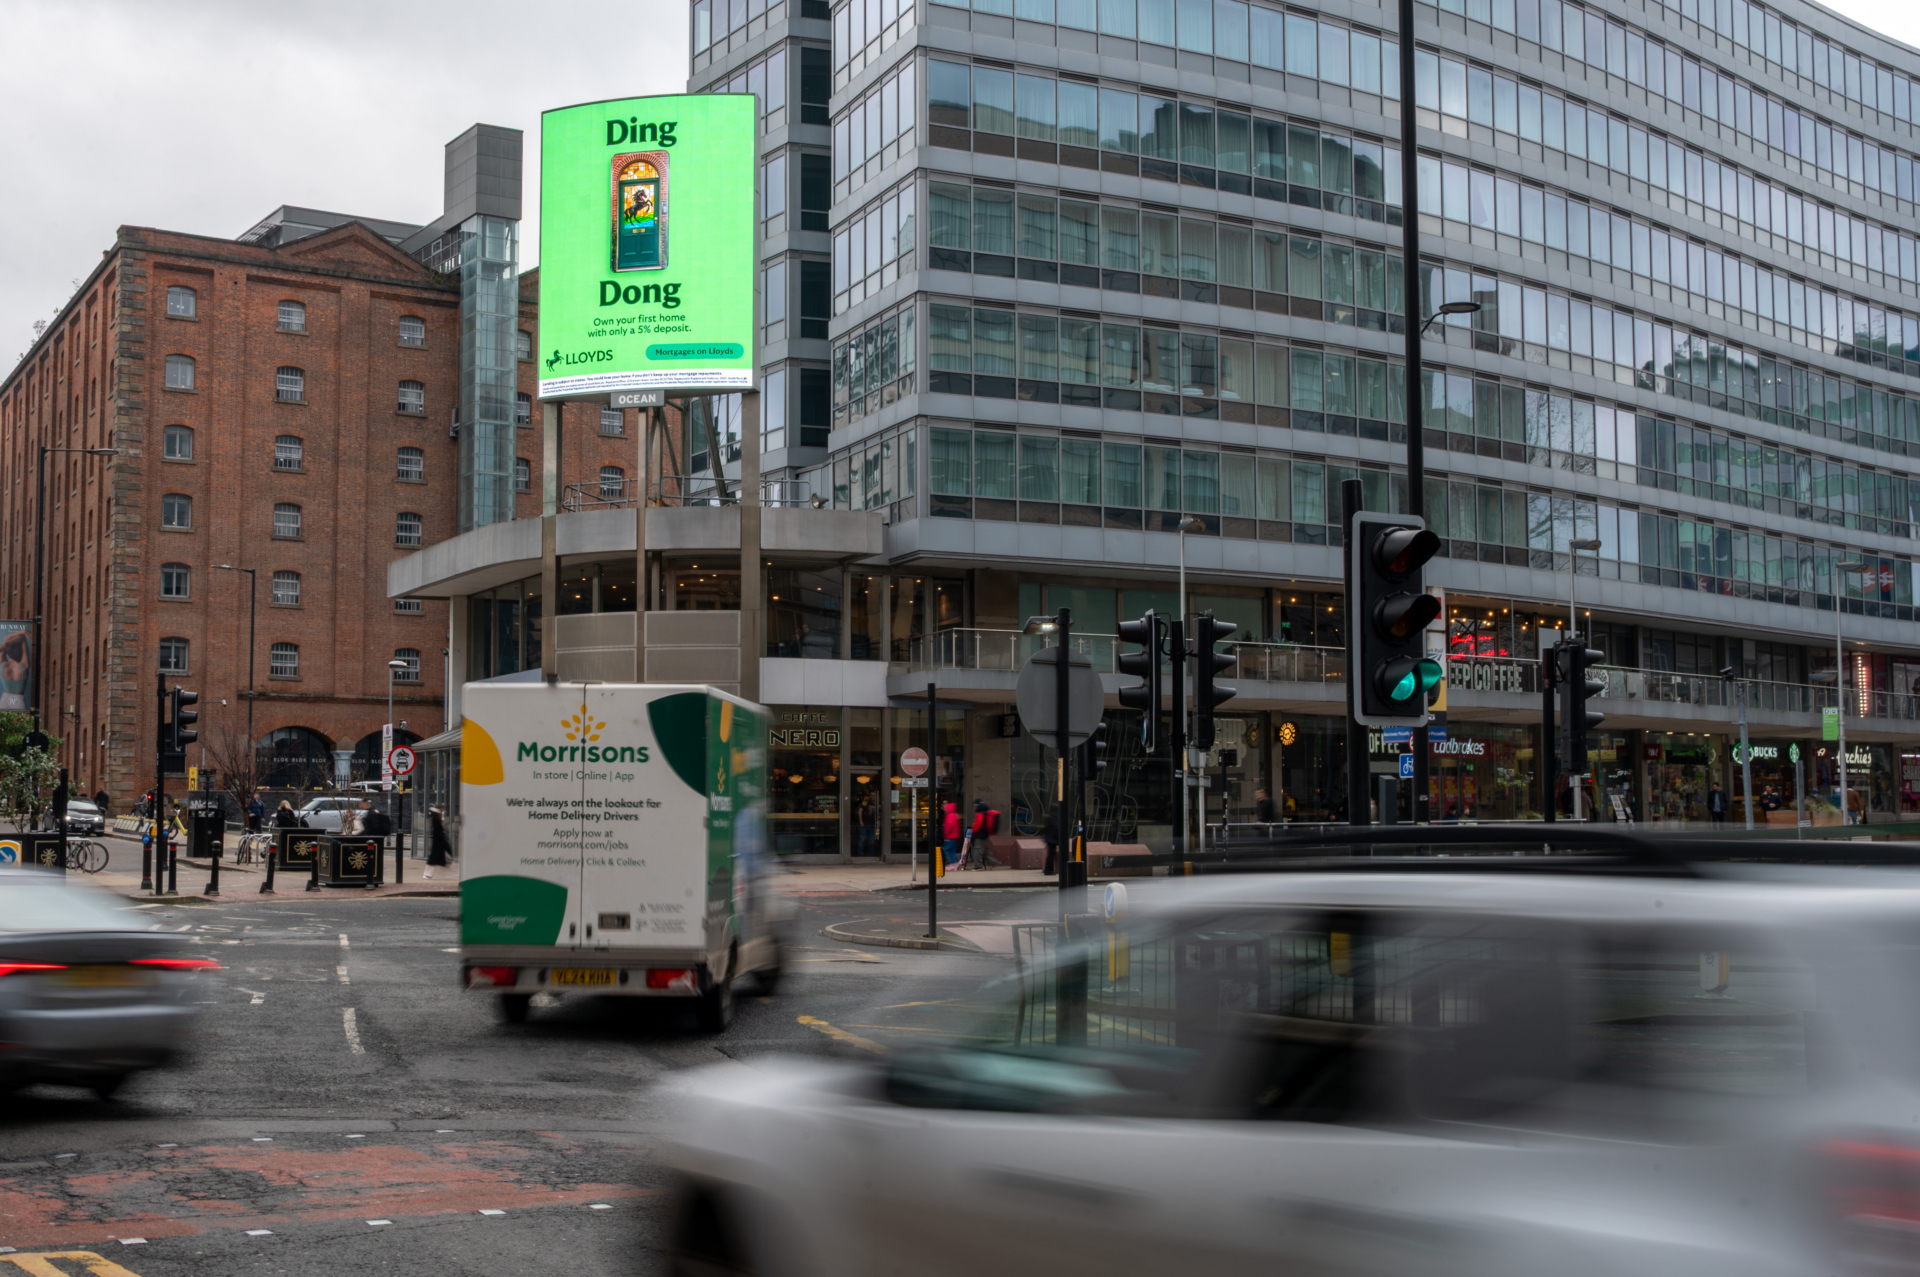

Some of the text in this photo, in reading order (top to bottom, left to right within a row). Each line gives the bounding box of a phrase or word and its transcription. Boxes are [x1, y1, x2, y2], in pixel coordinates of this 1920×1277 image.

[606, 116, 678, 148] Ding
[599, 280, 682, 309] Dong
[593, 313, 686, 327] Own your first home
[587, 328, 606, 338] with
[608, 326, 628, 337] only
[637, 324, 652, 334] 5%
[654, 323, 692, 335] deposit.
[565, 350, 614, 365] LLOYDS
[655, 348, 695, 356] Mortgages
[708, 347, 734, 356] Lloyds
[618, 394, 657, 404] OCEAN
[1450, 662, 1523, 692] EEP COFFEE
[782, 710, 828, 723] CAFFÈ
[770, 729, 840, 746] NERO
[1369, 733, 1400, 754] OFFEE
[517, 738, 649, 763] Morrisons
[1434, 738, 1485, 755] Ladbrokes
[1754, 747, 1778, 758] BUCKS
[532, 770, 635, 782] In store Online App
[506, 798, 534, 807] We're
[536, 797, 568, 809] always
[585, 798, 602, 808] the
[605, 798, 644, 808] lookout
[646, 798, 662, 808] for
[528, 811, 639, 823] Home Delivery Drivers
[553, 828, 613, 840] Apply now at
[537, 840, 629, 852] morrisons.com/jobs
[520, 857, 646, 867] Home Delivery Click & Collect
